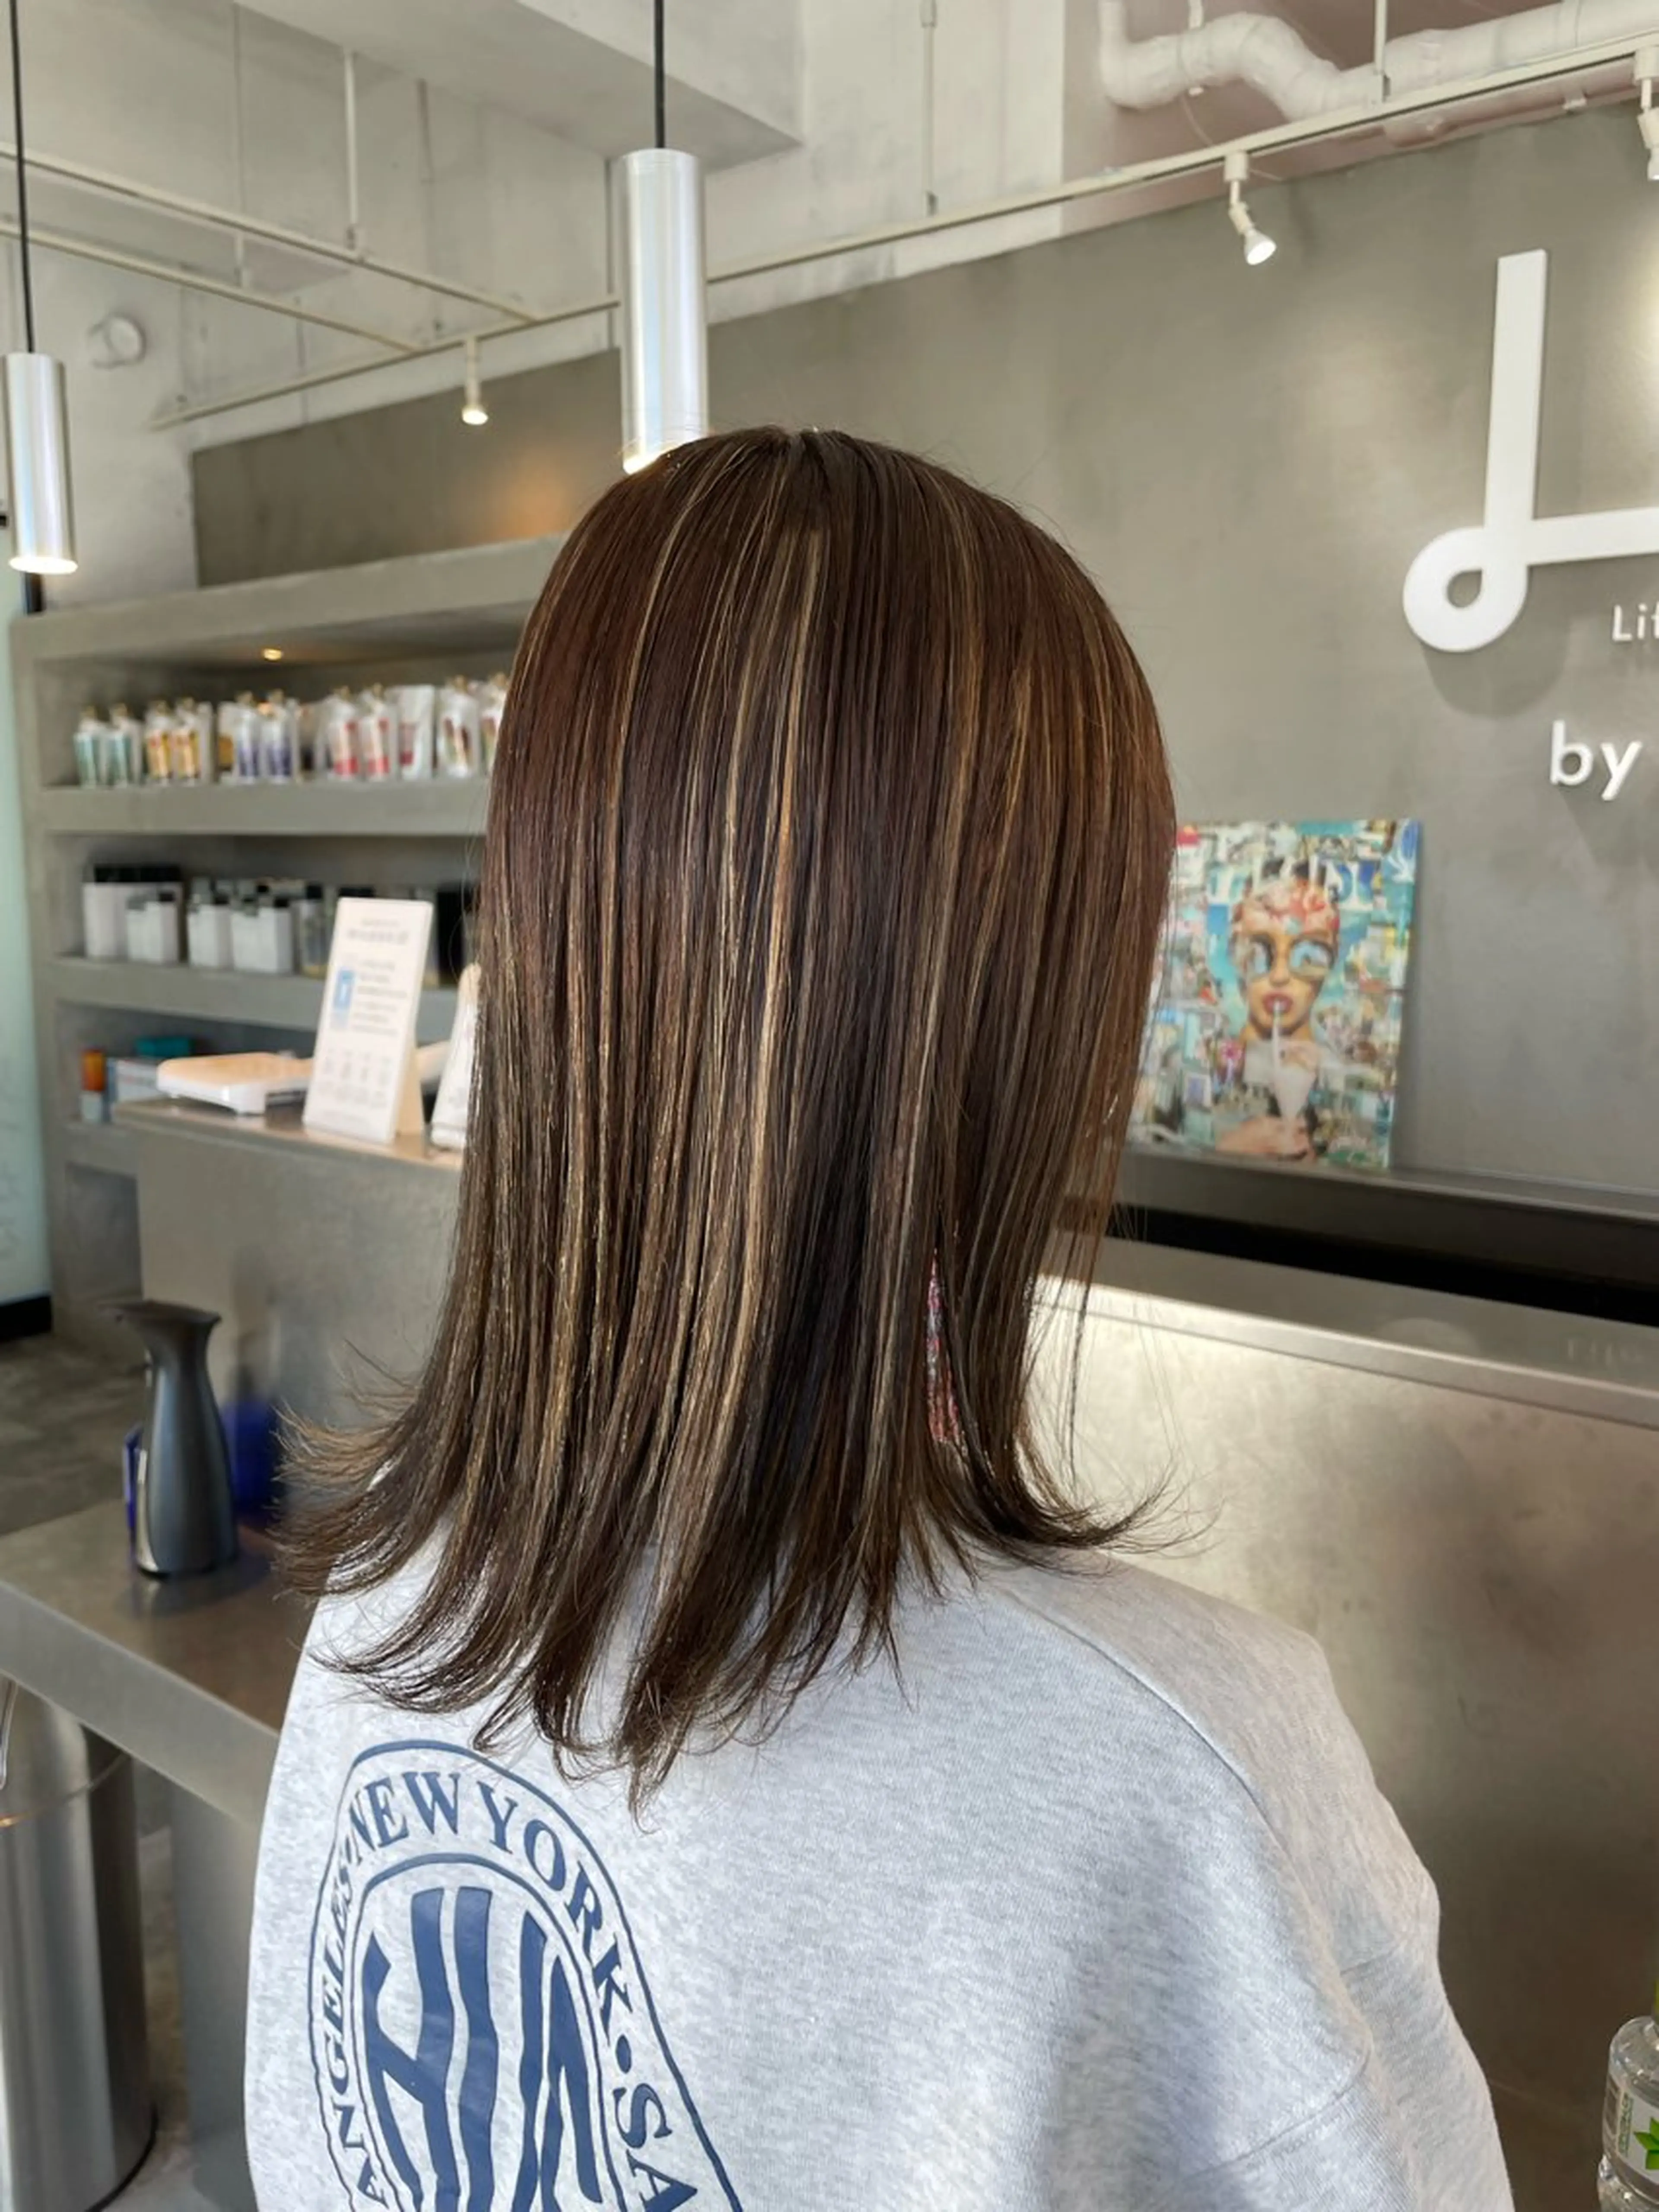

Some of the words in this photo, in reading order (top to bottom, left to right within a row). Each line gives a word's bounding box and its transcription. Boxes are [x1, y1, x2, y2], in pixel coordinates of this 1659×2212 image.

[1551, 720, 1642, 800] by
[349, 1772, 461, 1865] NEW
[477, 1781, 633, 2047] YORK
